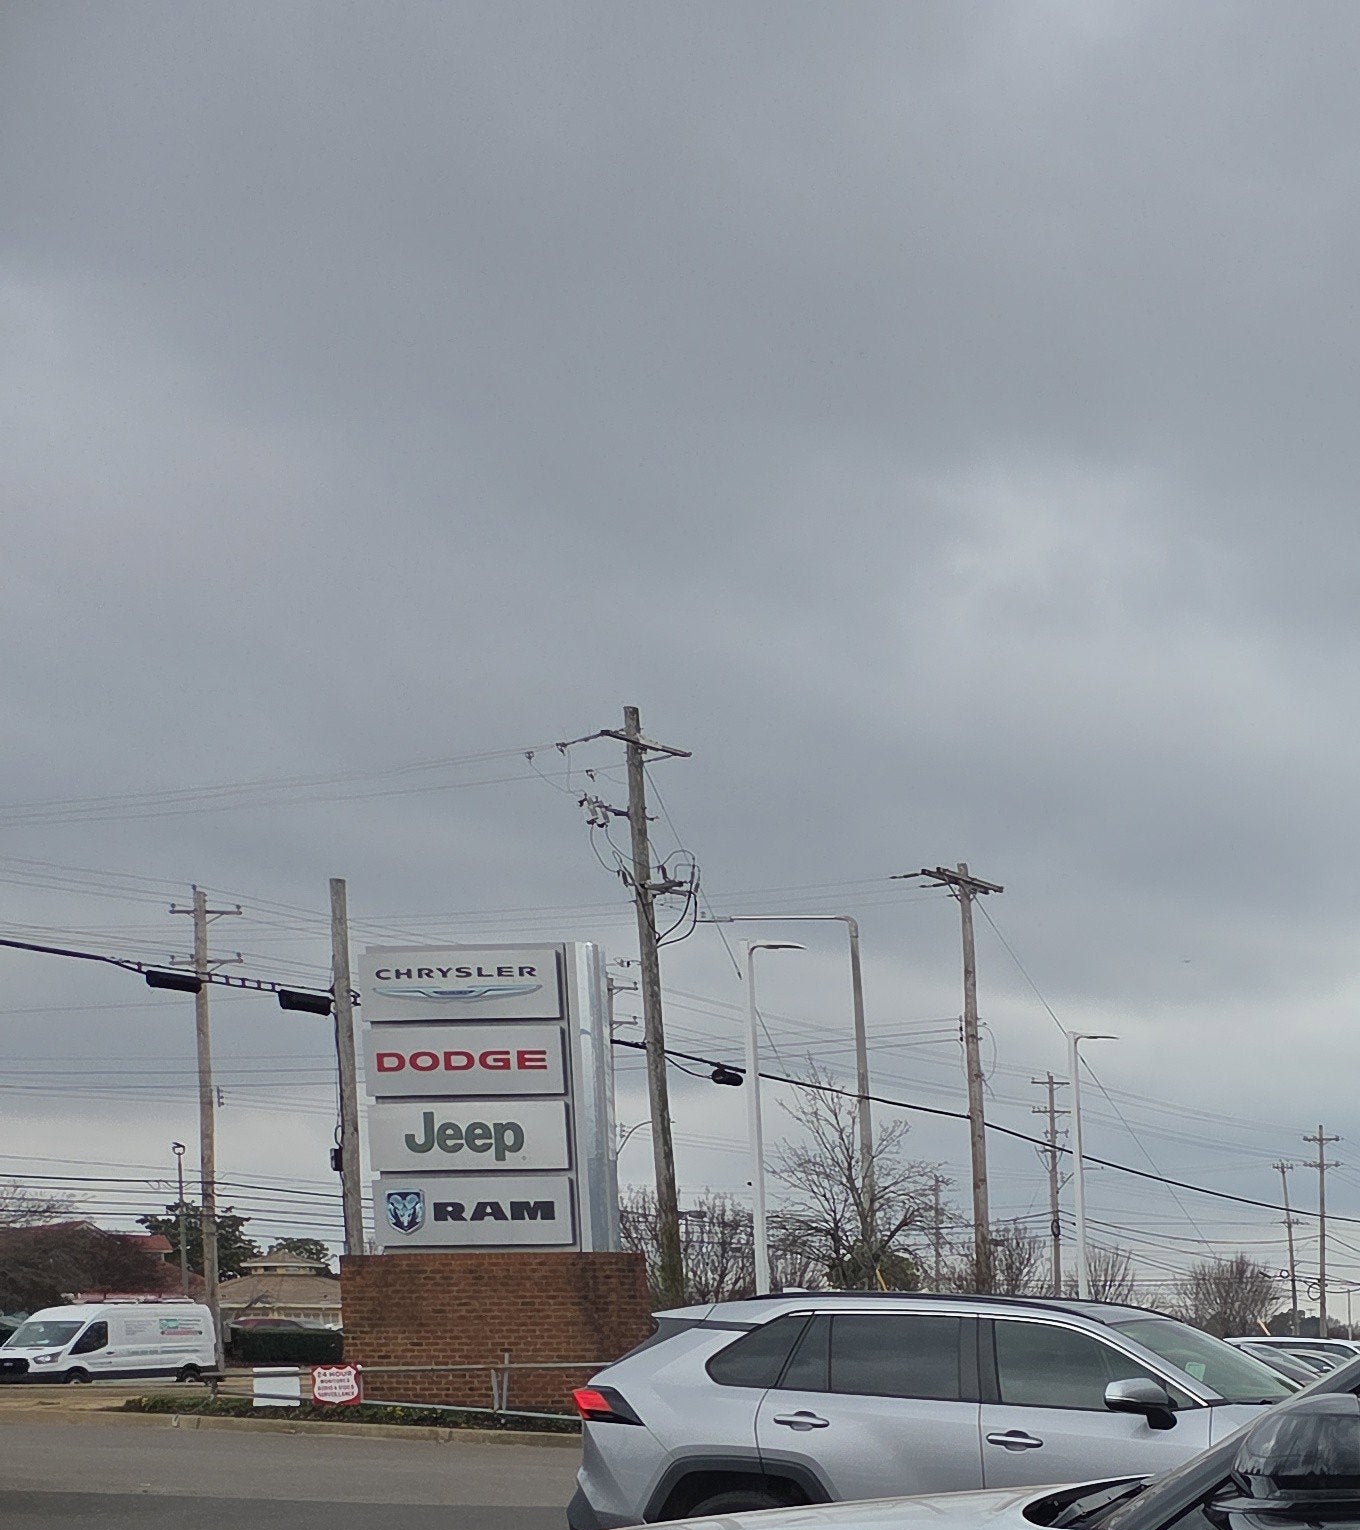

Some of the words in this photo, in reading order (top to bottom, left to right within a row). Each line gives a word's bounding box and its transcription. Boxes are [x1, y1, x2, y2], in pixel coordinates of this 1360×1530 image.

[375, 965, 538, 981] CHRYSLER
[375, 1049, 548, 1073] DODGE
[404, 1111, 525, 1162] Jeep
[432, 1200, 556, 1222] RAM
